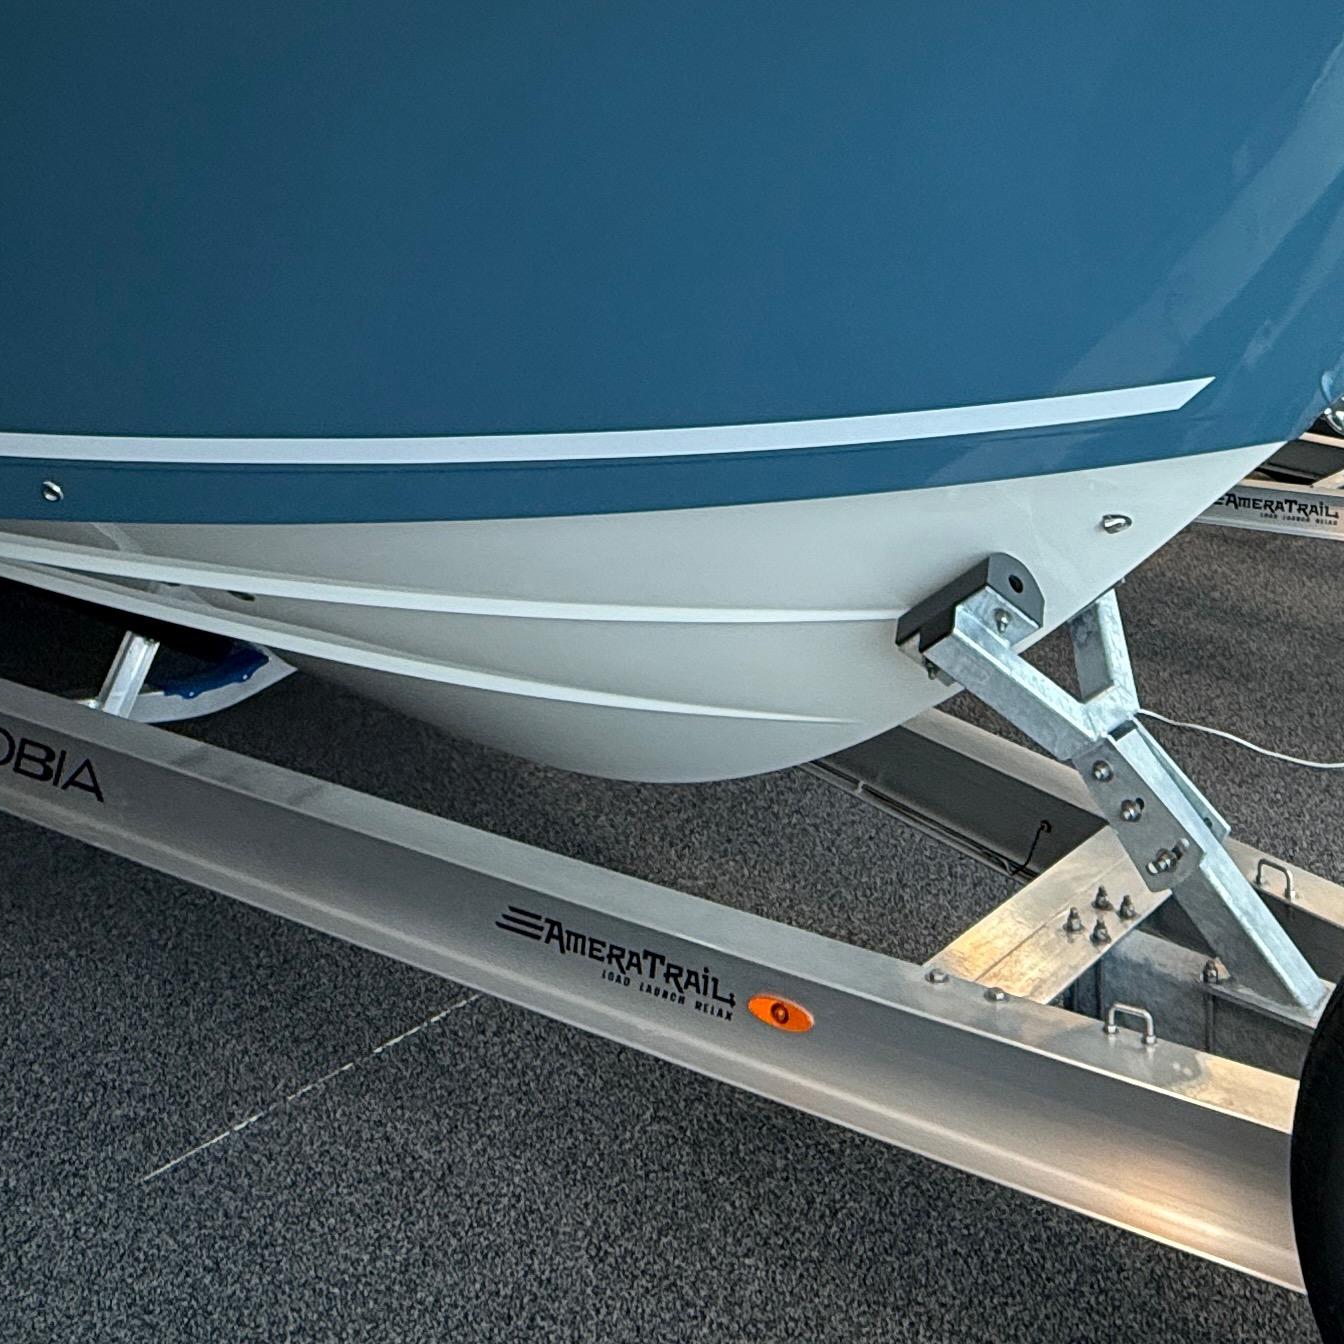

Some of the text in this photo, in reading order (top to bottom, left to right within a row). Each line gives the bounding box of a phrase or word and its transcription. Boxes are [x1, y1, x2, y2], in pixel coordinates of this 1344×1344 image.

[601, 969, 734, 1022] LOAD LAUNCH RELAX
